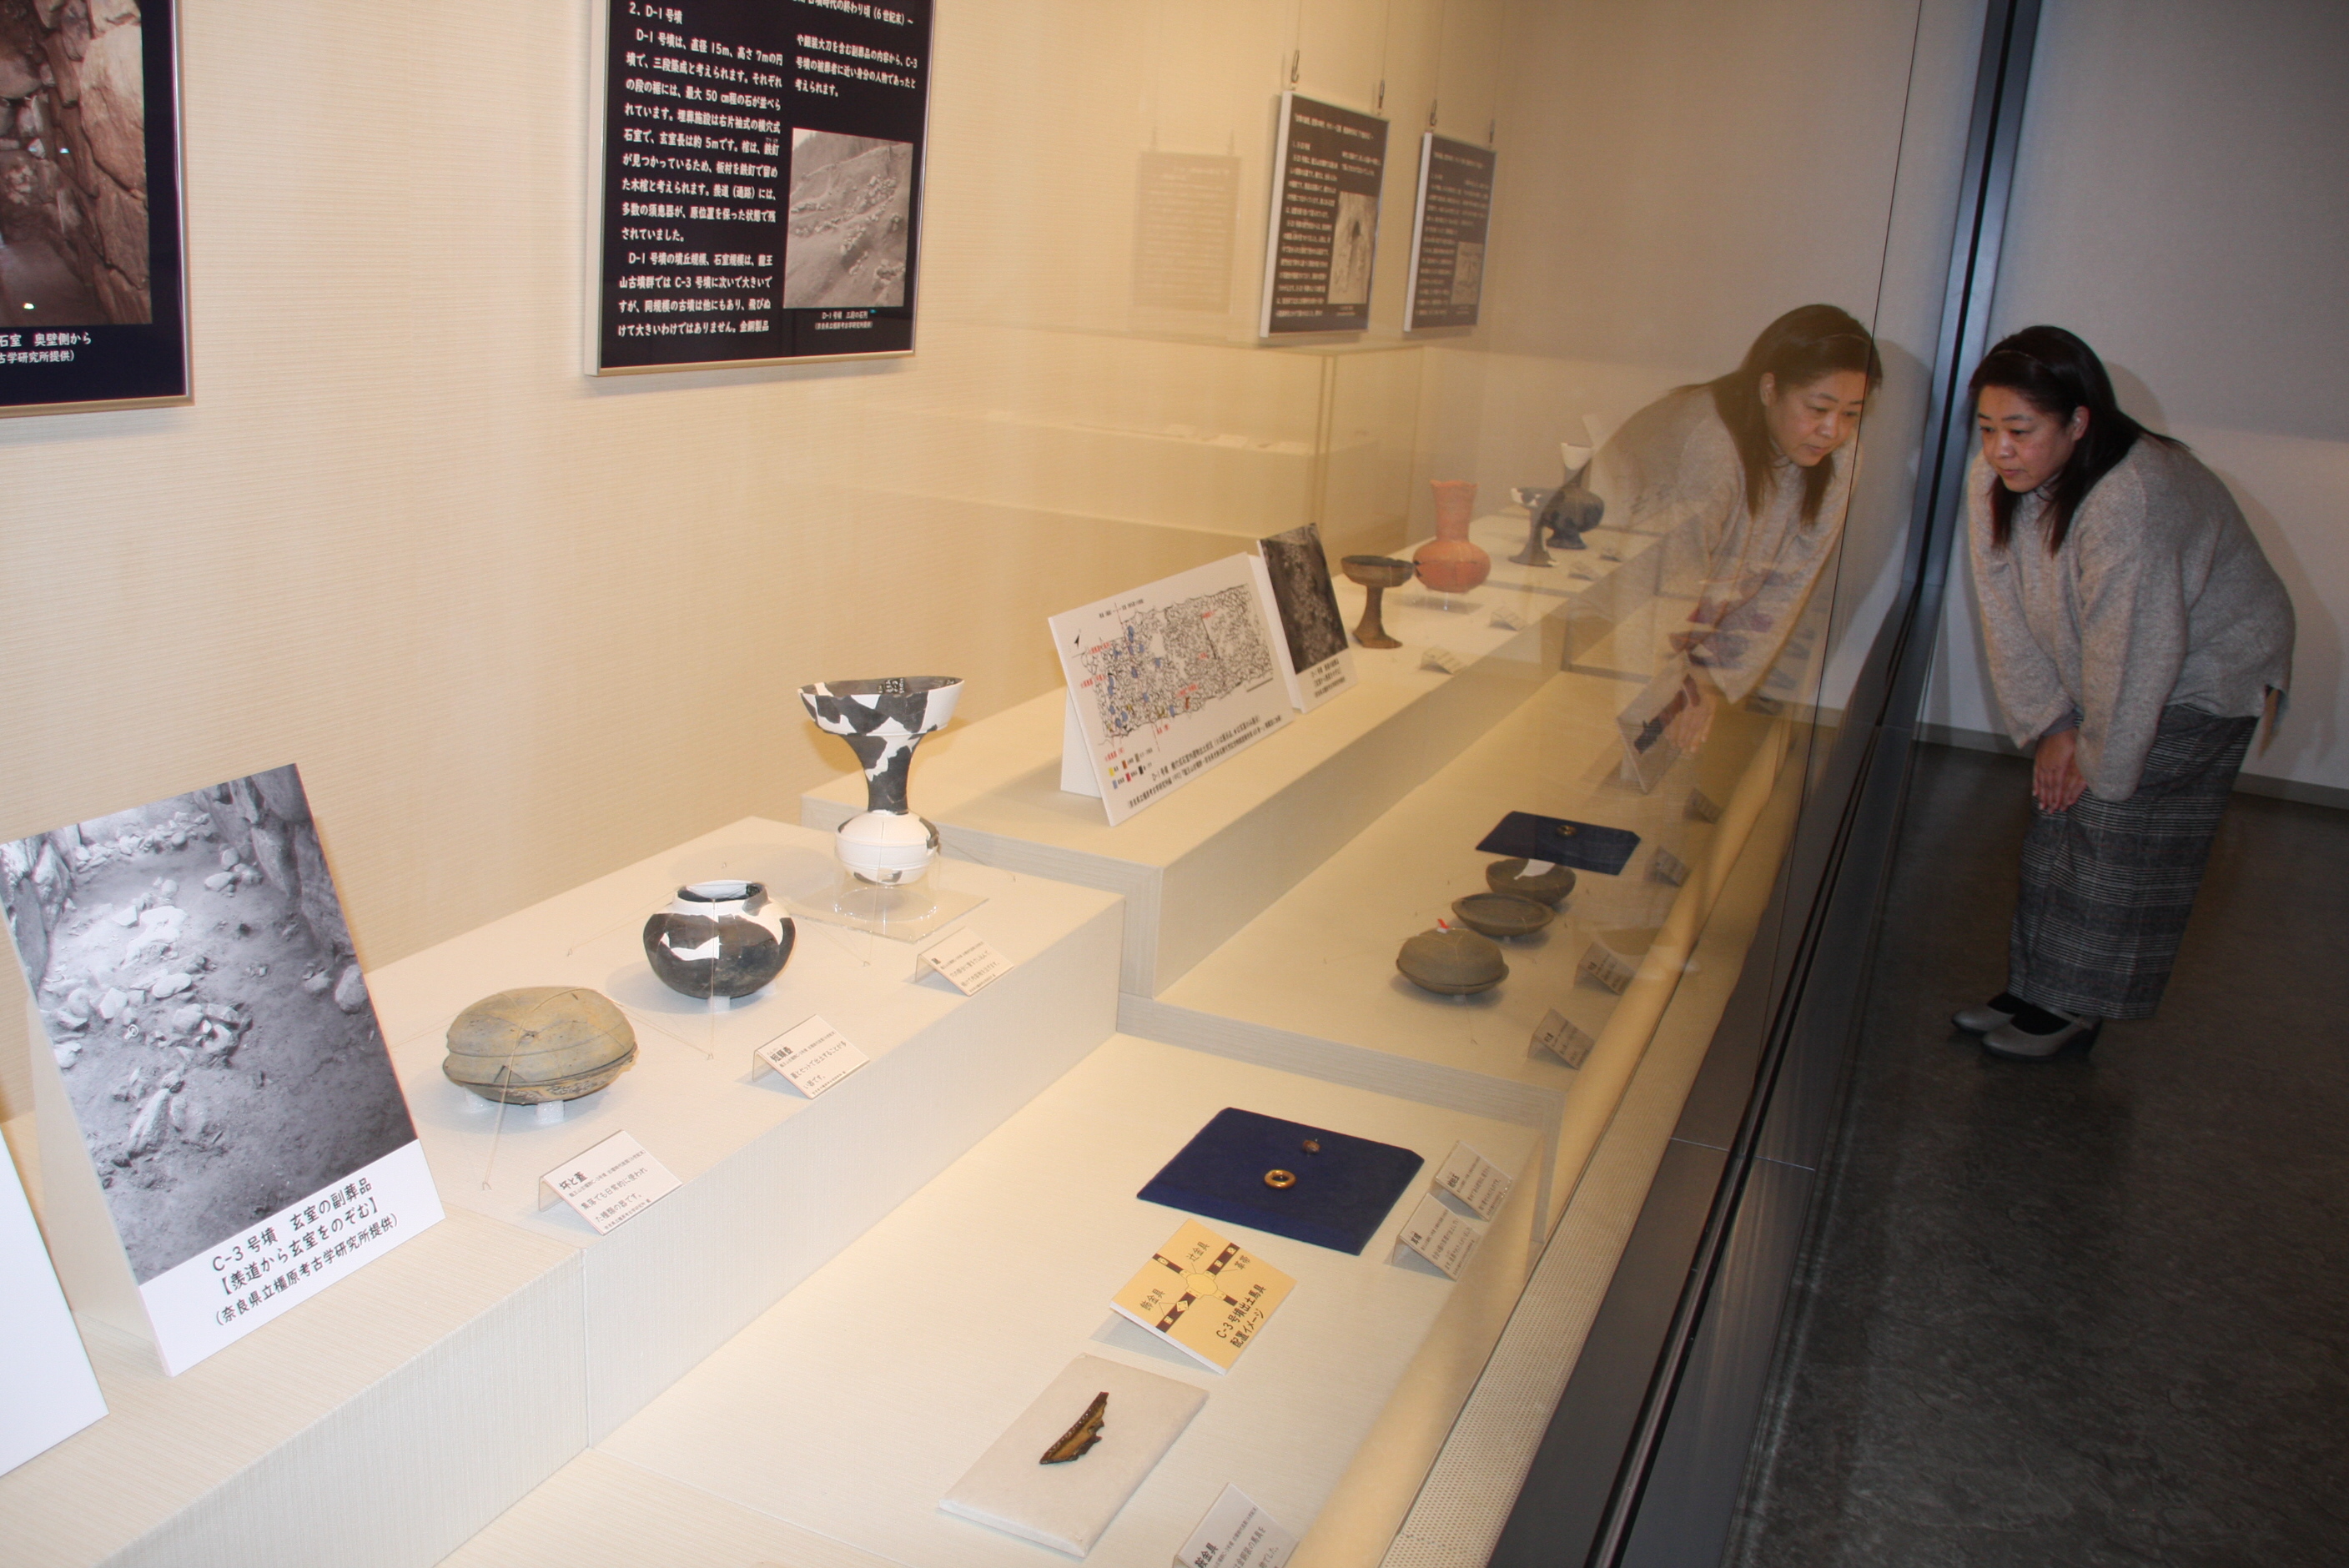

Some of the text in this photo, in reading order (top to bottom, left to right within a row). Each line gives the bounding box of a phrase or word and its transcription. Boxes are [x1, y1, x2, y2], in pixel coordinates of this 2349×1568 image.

[794, 78, 839, 98] 考えられます。
[621, 226, 685, 242] されていました。
[34, 332, 92, 347] 奥壁側から
[581, 1167, 648, 1210] 集落でも日常的に使われ
[595, 1193, 642, 1224] た種類の器です。
[1230, 1308, 1265, 1349] 配置イメージ
